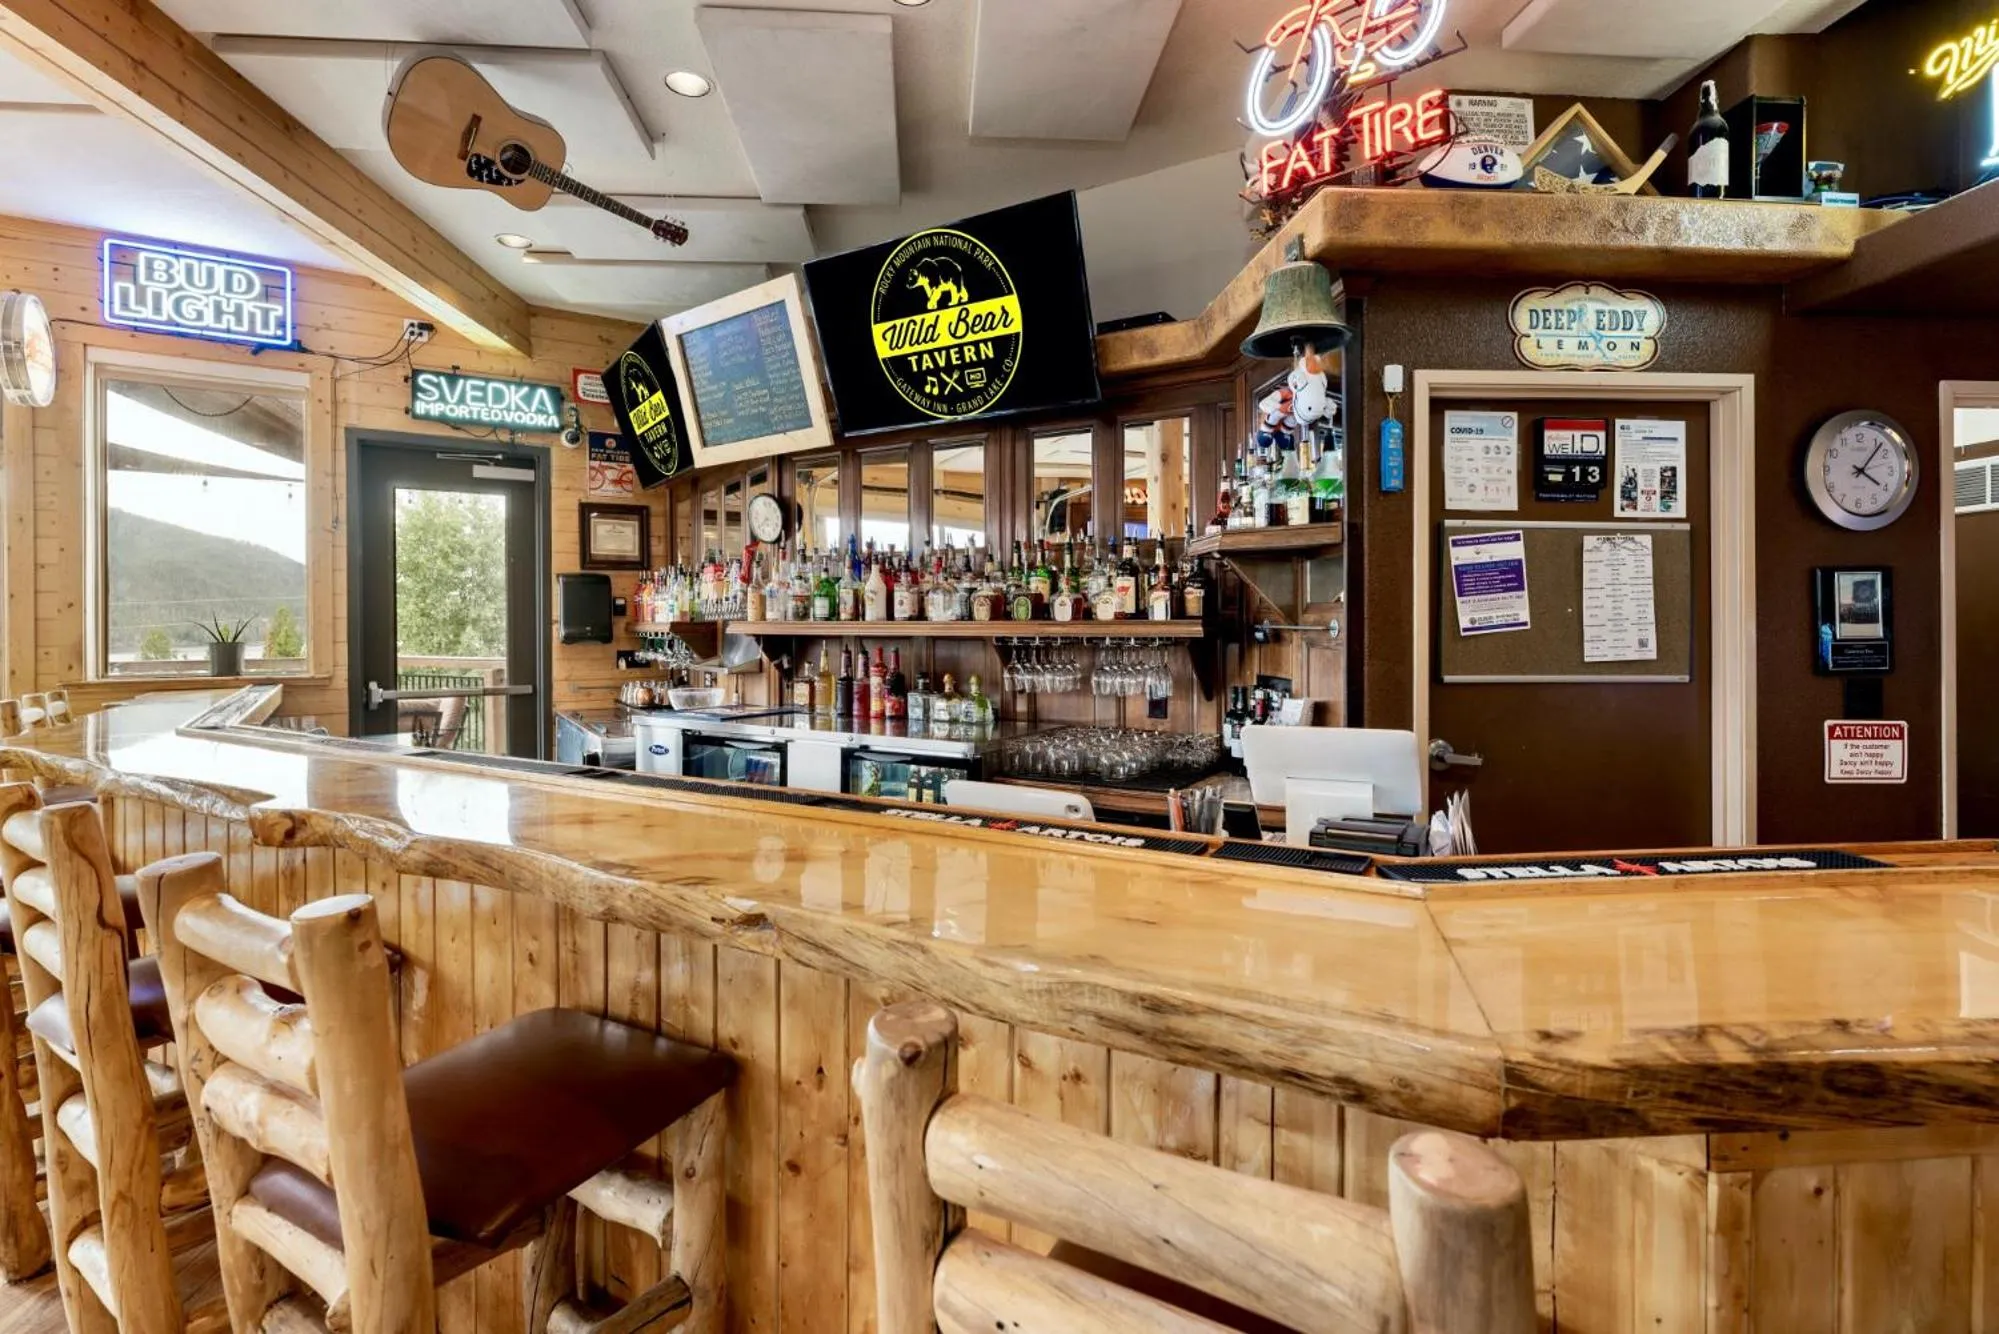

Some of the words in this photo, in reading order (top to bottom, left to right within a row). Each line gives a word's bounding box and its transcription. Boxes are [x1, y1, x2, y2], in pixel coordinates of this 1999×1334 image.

[1260, 127, 1340, 195] FAT
[1349, 89, 1445, 160] TIRE
[1470, 144, 1505, 157] DENVER
[879, 265, 898, 295] ROCKY
[893, 236, 932, 267] MOUNTAIN
[933, 235, 973, 254] NATIONAL
[973, 247, 995, 271] PARK
[138, 251, 261, 300] BUD
[1528, 308, 1577, 330] DEEP
[1595, 309, 1648, 331] EDDY
[882, 314, 941, 352] Wild
[948, 304, 1015, 340] Bear
[1536, 339, 1641, 351] LEMON
[907, 341, 995, 374] TAVERN
[896, 377, 931, 410] GATEWAY
[932, 400, 948, 414] INN
[955, 397, 985, 415] GRAND
[985, 378, 1004, 401] LAKE
[1002, 357, 1014, 374] CO
[416, 373, 555, 414] SVEDKA
[415, 400, 501, 422] IMPORTED
[501, 411, 560, 428] VODKA
[1450, 426, 1484, 435] COVID-19
[1841, 438, 1848, 447] 11
[1855, 432, 1865, 443] 12
[1547, 443, 1570, 454] WE
[1829, 448, 1838, 459] 10
[1882, 449, 1889, 459] 2
[591, 453, 608, 461] FAT
[1571, 465, 1600, 483] 13
[1888, 466, 1894, 477] 3
[1883, 484, 1888, 493] 4
[1841, 494, 1847, 503] 7
[1855, 499, 1862, 508] 6
[1870, 494, 1877, 505] 5
[1833, 725, 1900, 738] ATTENTION
